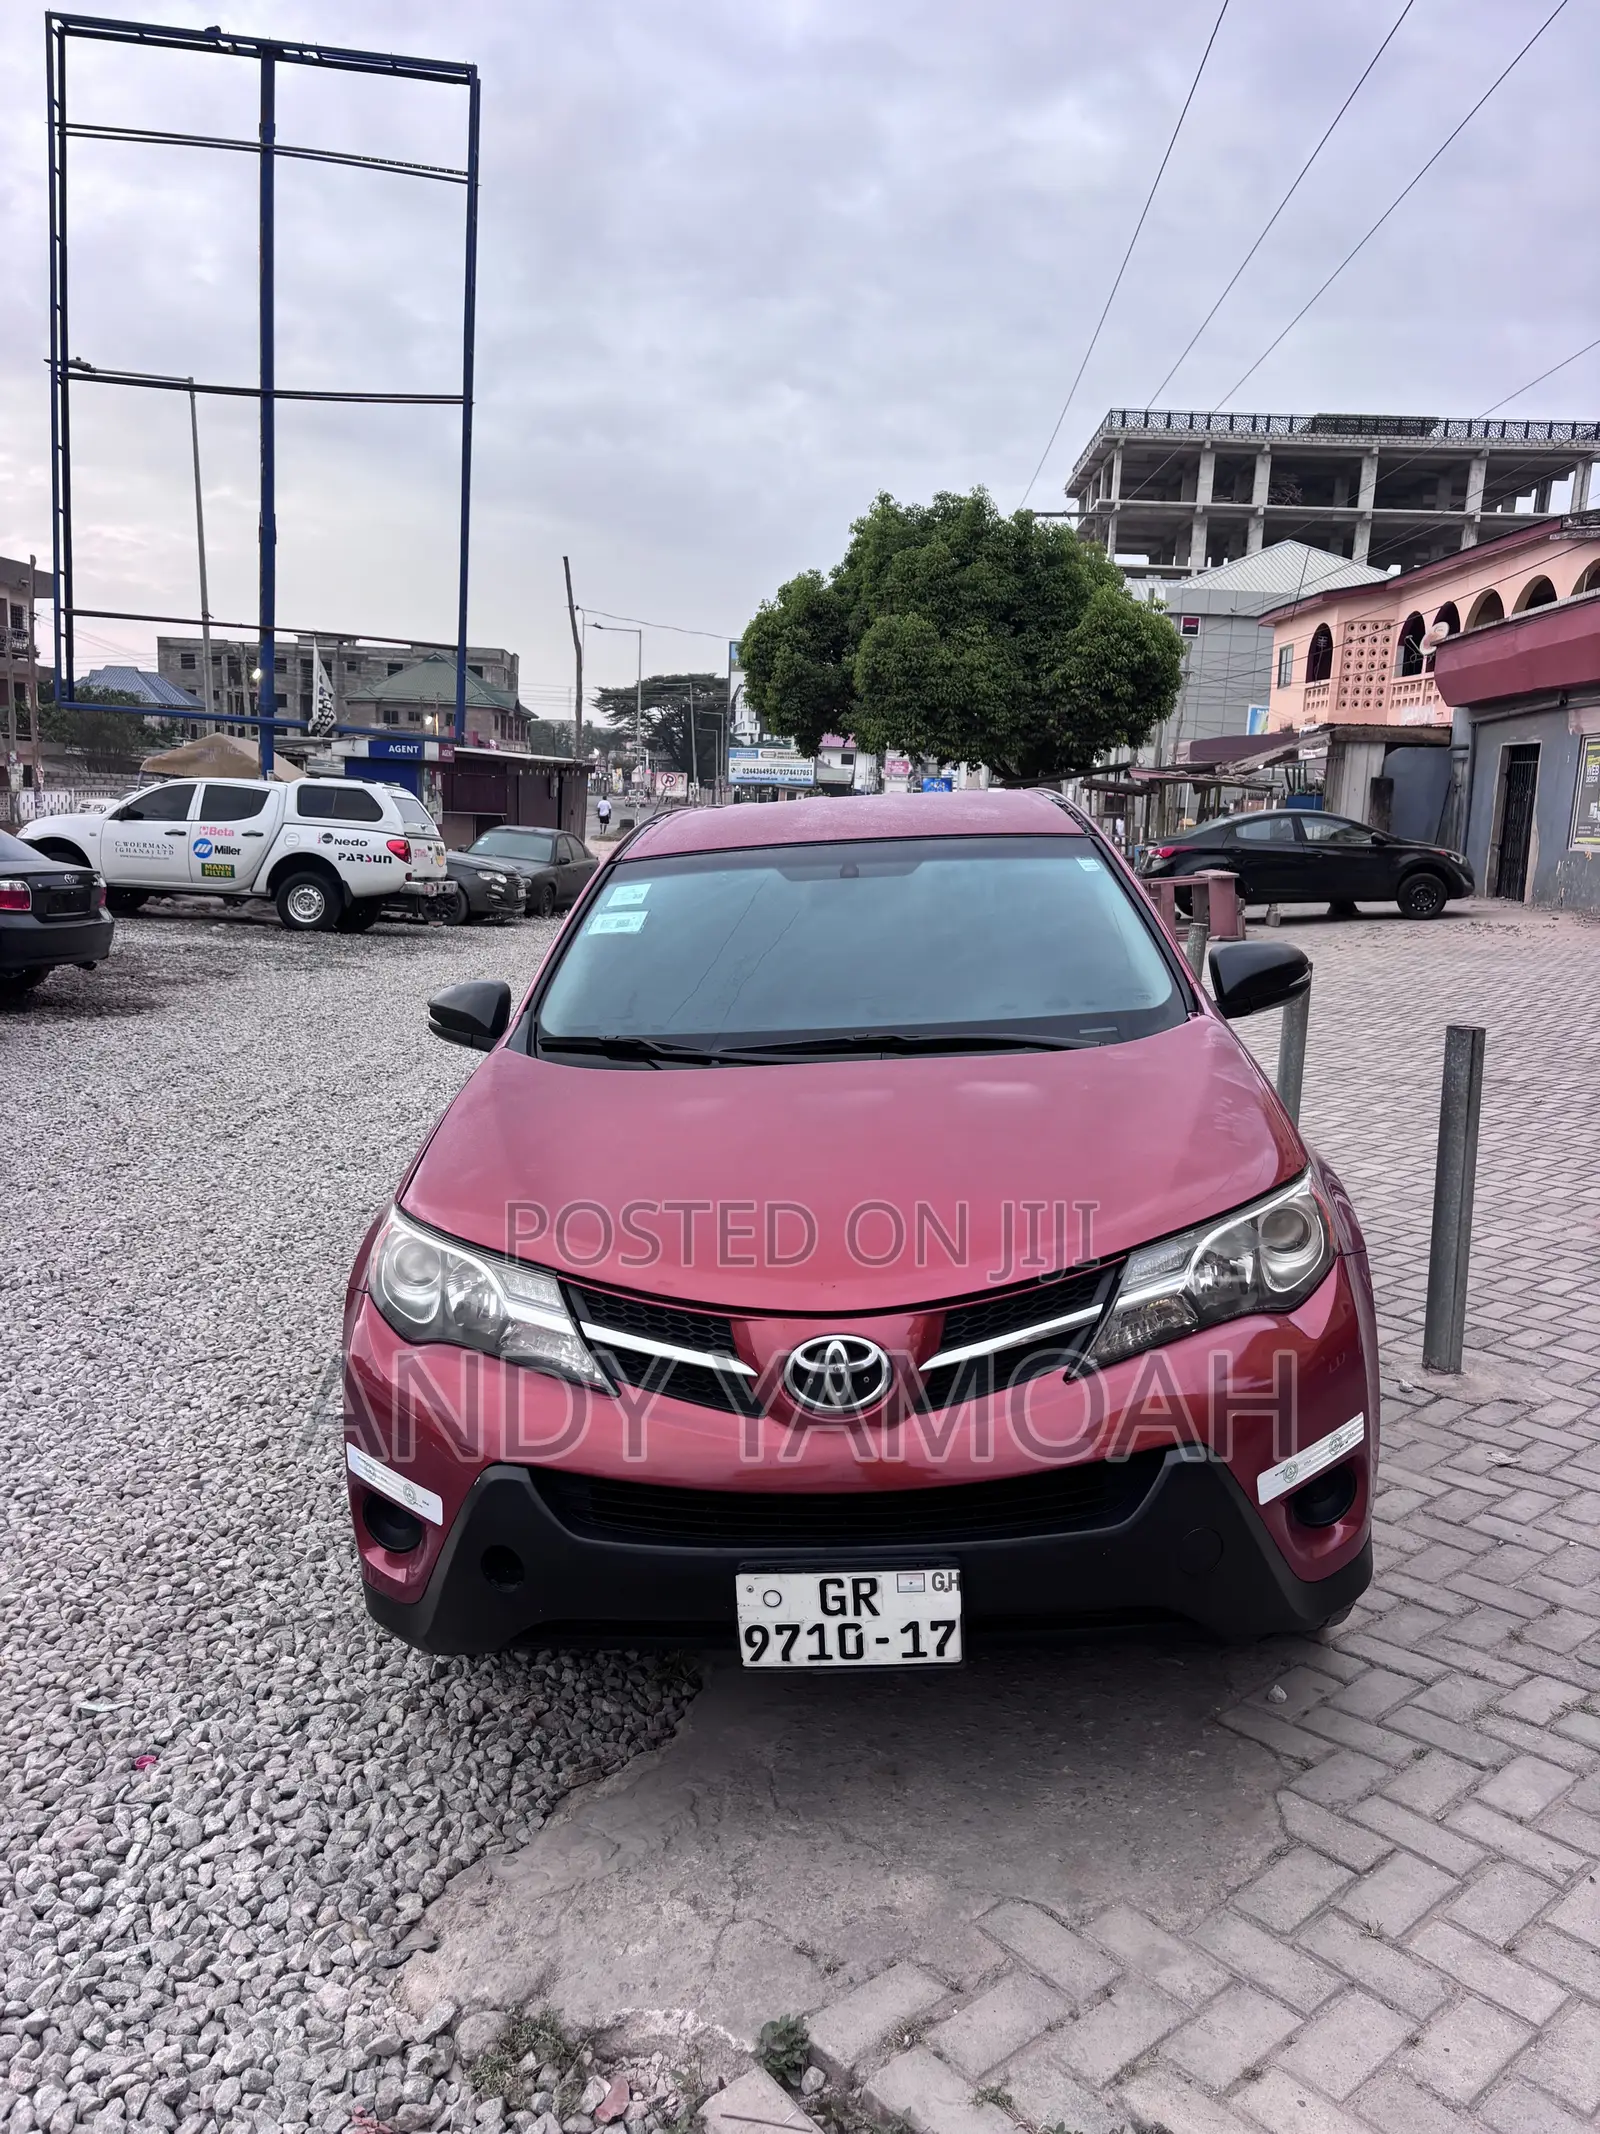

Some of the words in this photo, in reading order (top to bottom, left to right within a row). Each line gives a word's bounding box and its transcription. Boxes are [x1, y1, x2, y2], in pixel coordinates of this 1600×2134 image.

[388, 744, 419, 754] AGENT
[208, 826, 235, 837] Beta
[334, 838, 368, 847] Nedo
[214, 845, 242, 856] Miller
[932, 1572, 961, 1592] GH
[819, 1577, 880, 1617] GR
[744, 1620, 957, 1662] 9710-17
